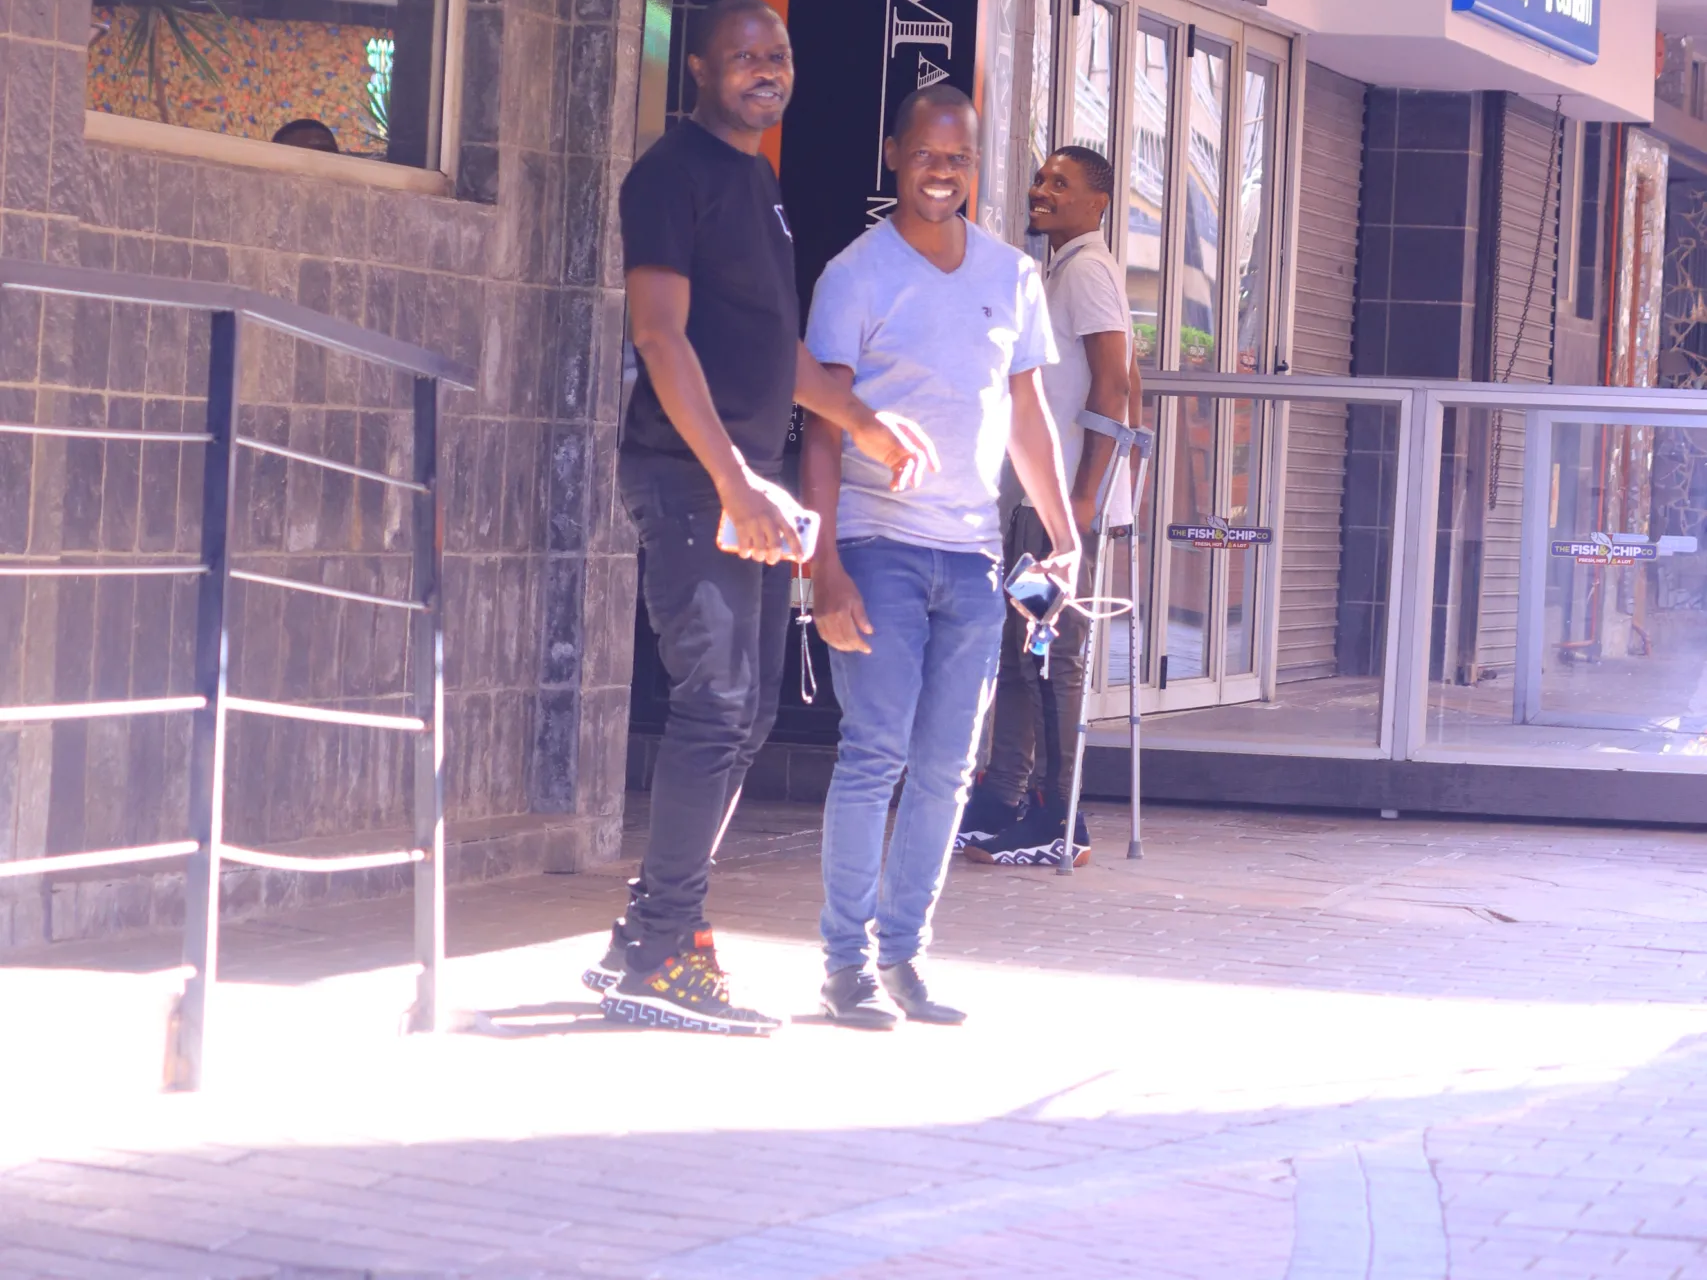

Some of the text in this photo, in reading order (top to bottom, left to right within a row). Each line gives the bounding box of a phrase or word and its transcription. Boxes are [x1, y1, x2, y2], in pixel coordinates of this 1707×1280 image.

[1172, 529, 1187, 537] THE
[1187, 528, 1215, 539] FISH
[1228, 530, 1257, 540] CHIP
[1256, 532, 1269, 540] CO
[1554, 545, 1570, 553] THE
[1571, 544, 1599, 556] FISH
[1613, 546, 1641, 557] CHIP
[1641, 548, 1654, 556] CO
